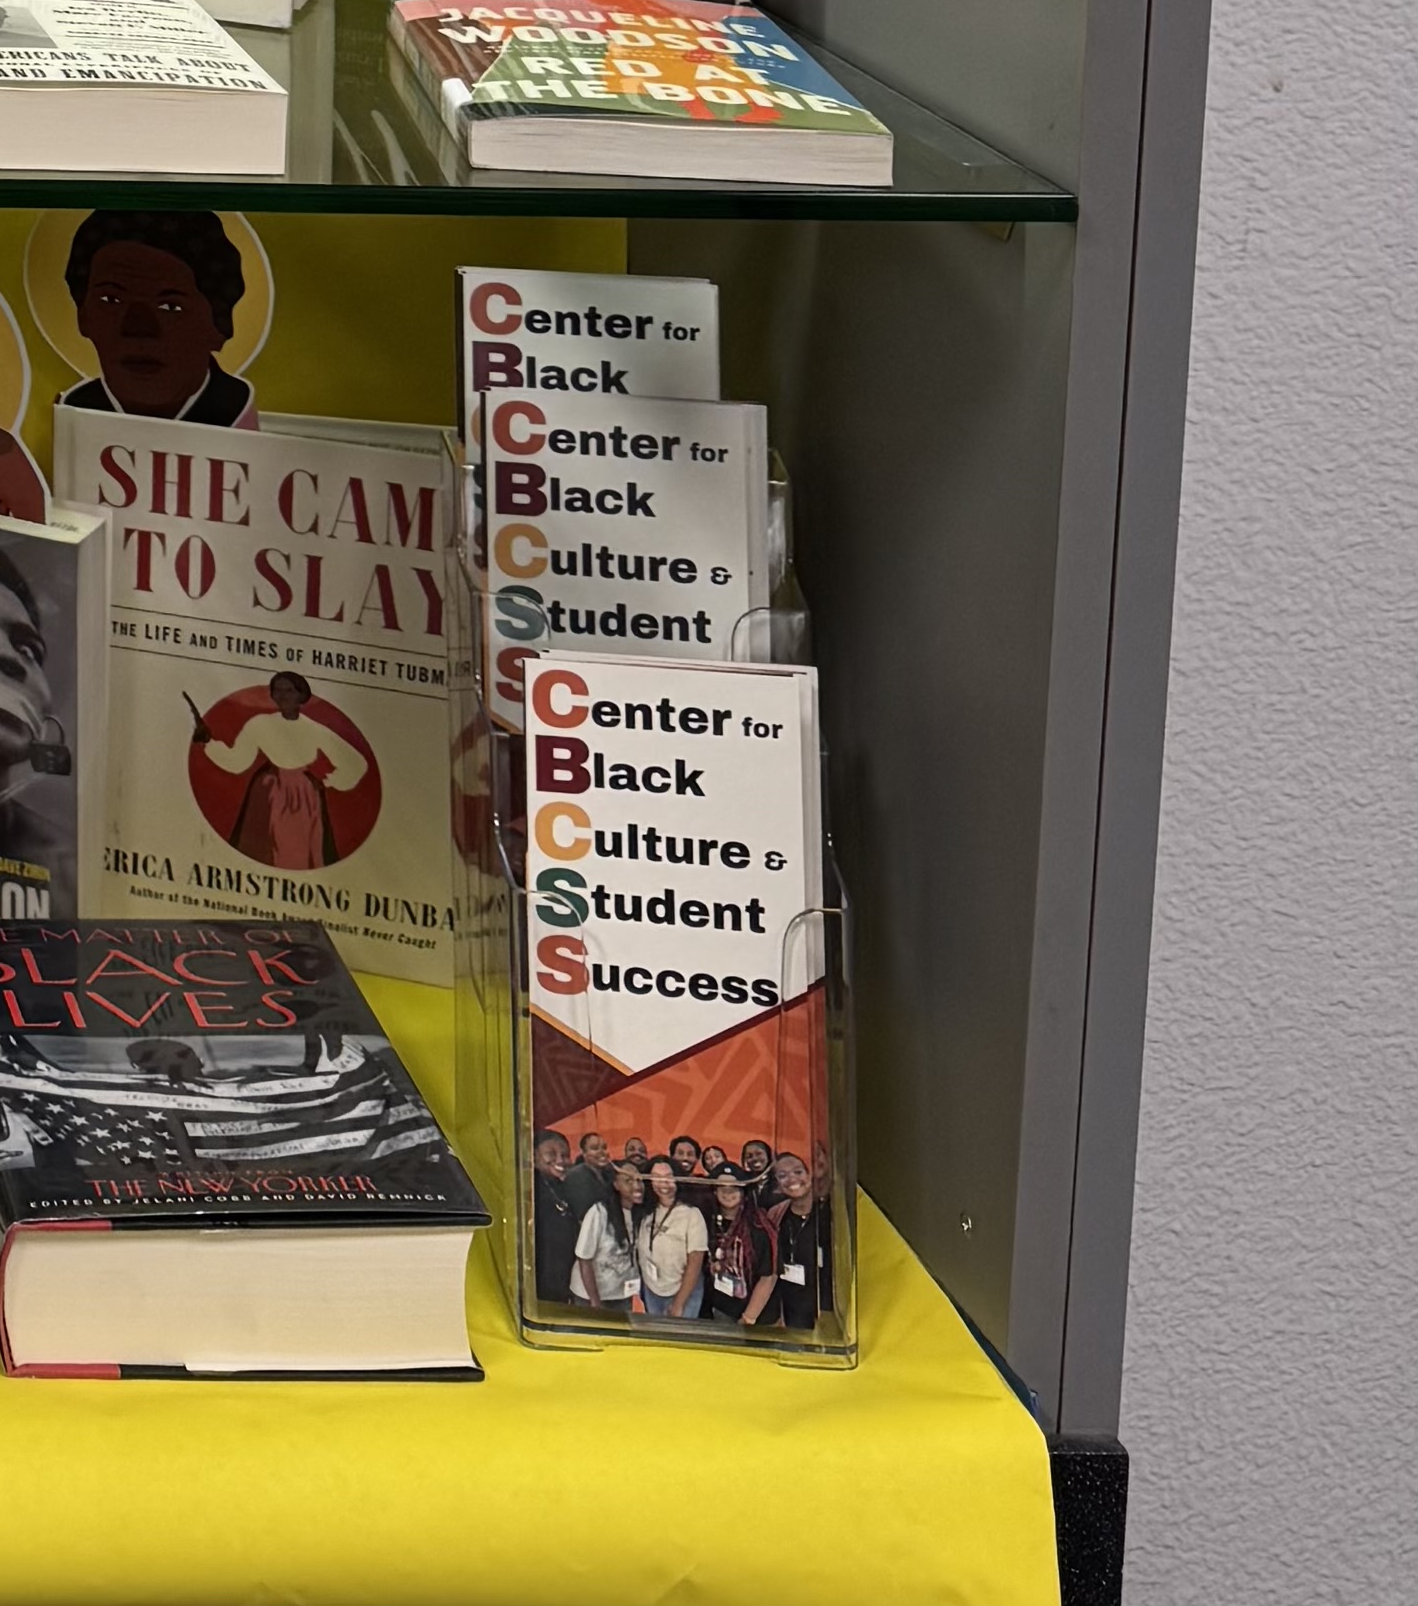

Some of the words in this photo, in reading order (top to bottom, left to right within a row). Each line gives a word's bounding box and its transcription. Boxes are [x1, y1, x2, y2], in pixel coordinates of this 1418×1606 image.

[123, 527, 216, 599] TO
[253, 545, 447, 638] SLAY
[533, 671, 732, 736] Center
[742, 717, 783, 739] for
[535, 735, 705, 796] Black
[535, 804, 750, 869] Culture
[765, 851, 787, 871] &
[536, 868, 765, 933] Student
[537, 936, 780, 1009] Success
[4, 990, 295, 1028] LIVES
